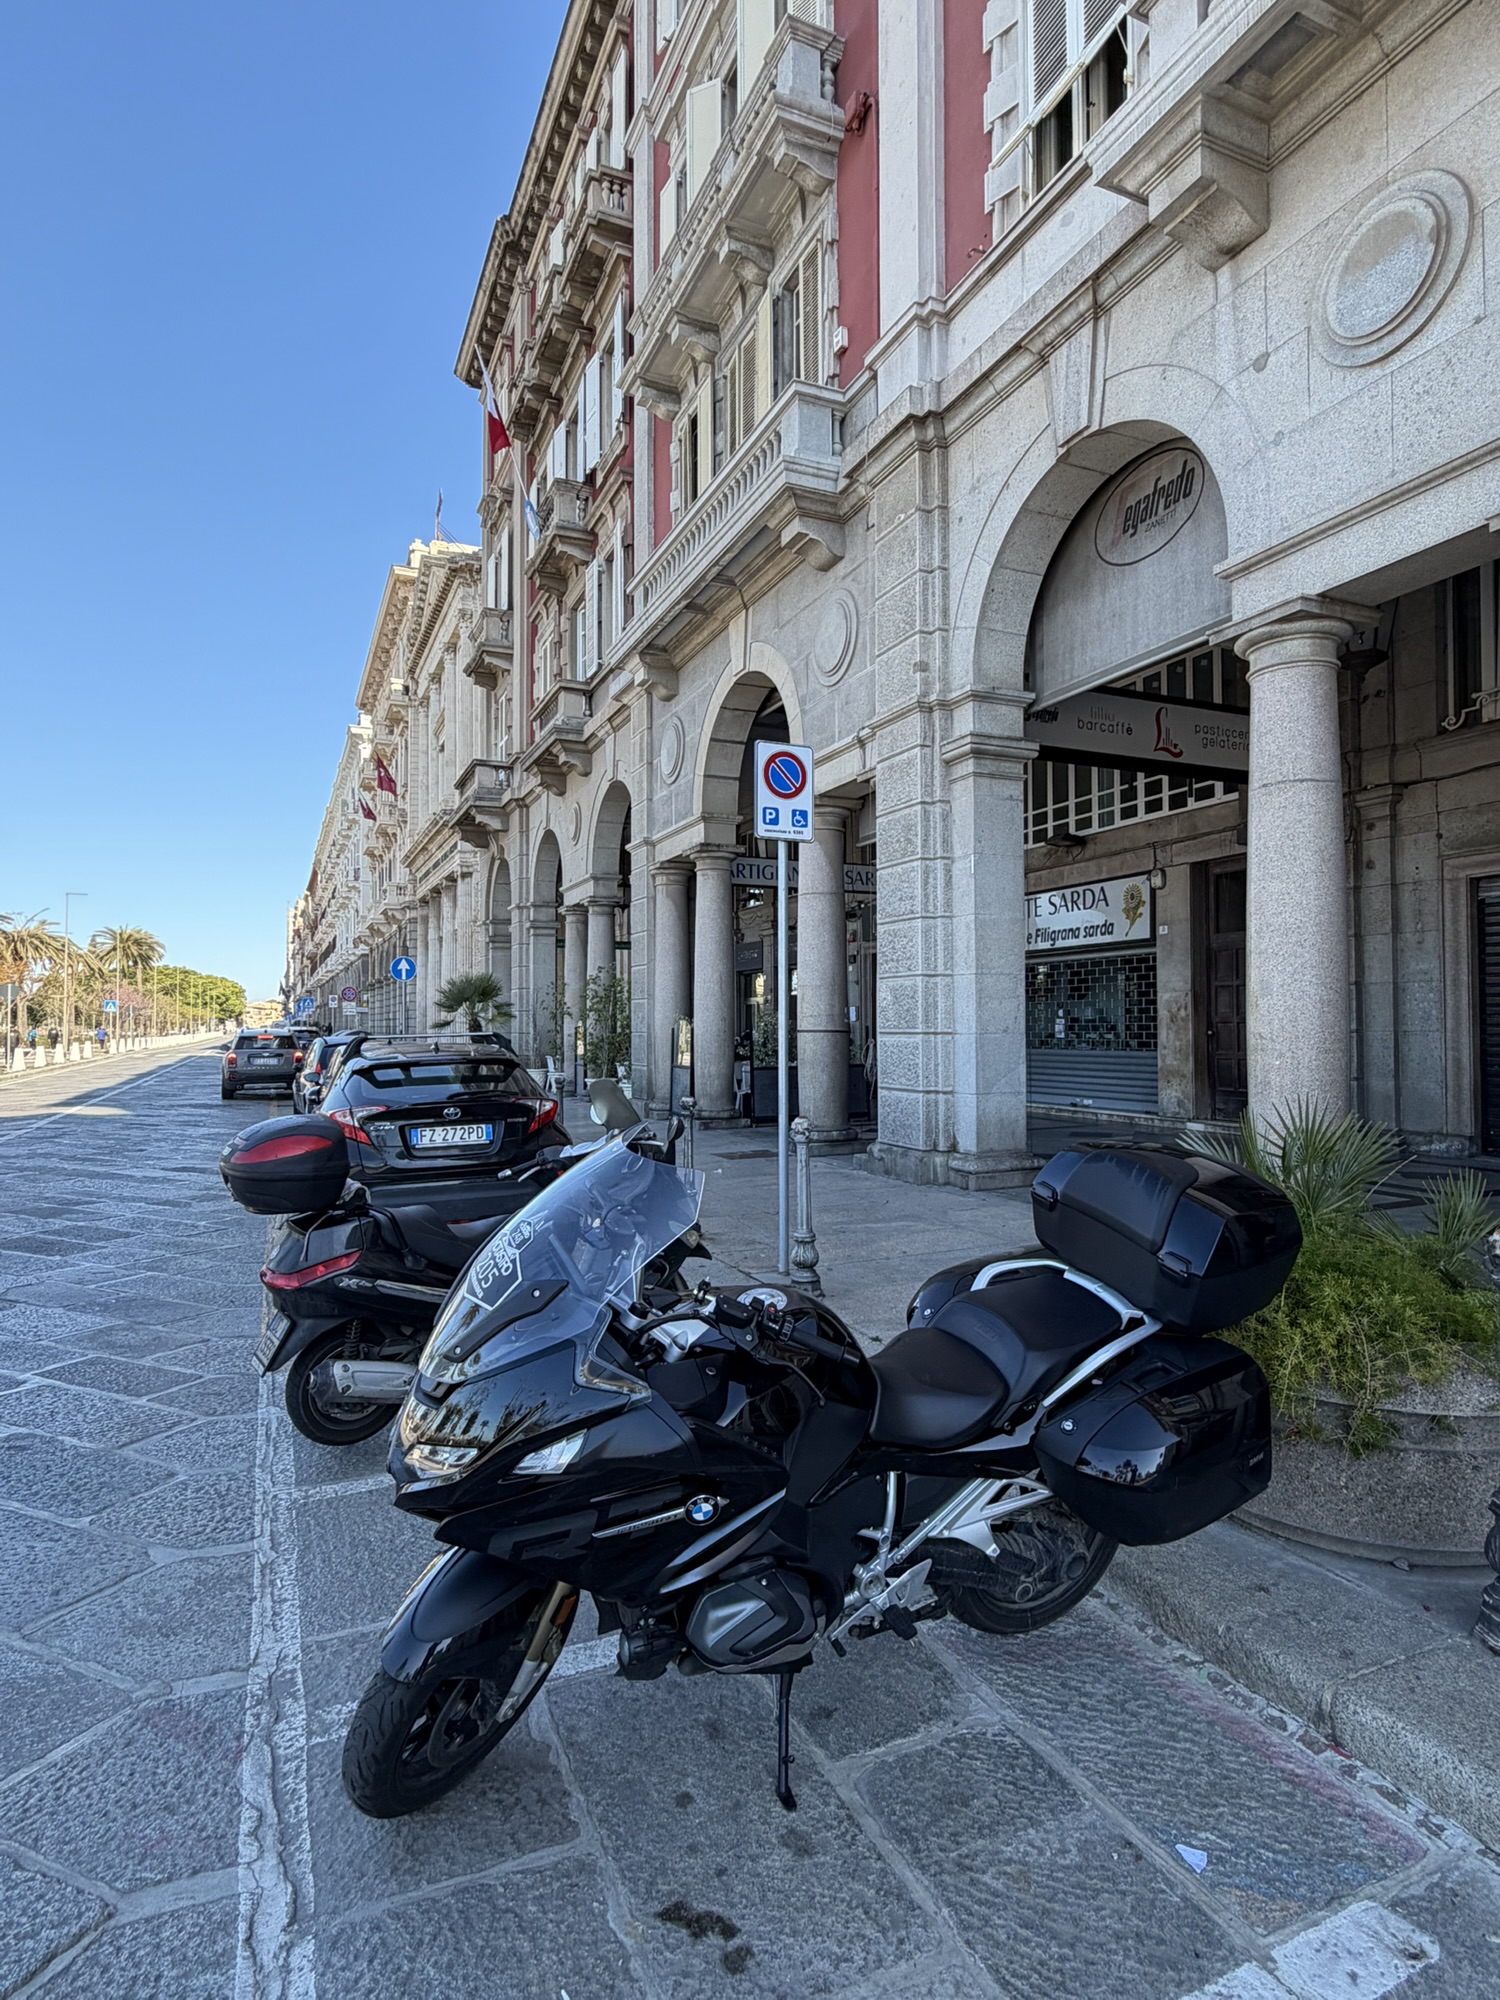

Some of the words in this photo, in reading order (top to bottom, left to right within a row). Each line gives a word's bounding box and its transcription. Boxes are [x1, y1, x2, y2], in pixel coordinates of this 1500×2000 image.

[1144, 508, 1177, 533] ZANETTI
[1048, 886, 1110, 915] SARDA
[1026, 932, 1033, 945] e
[1035, 925, 1081, 947] Filigrana
[1082, 919, 1115, 938] sarda
[476, 1252, 499, 1288] 205
